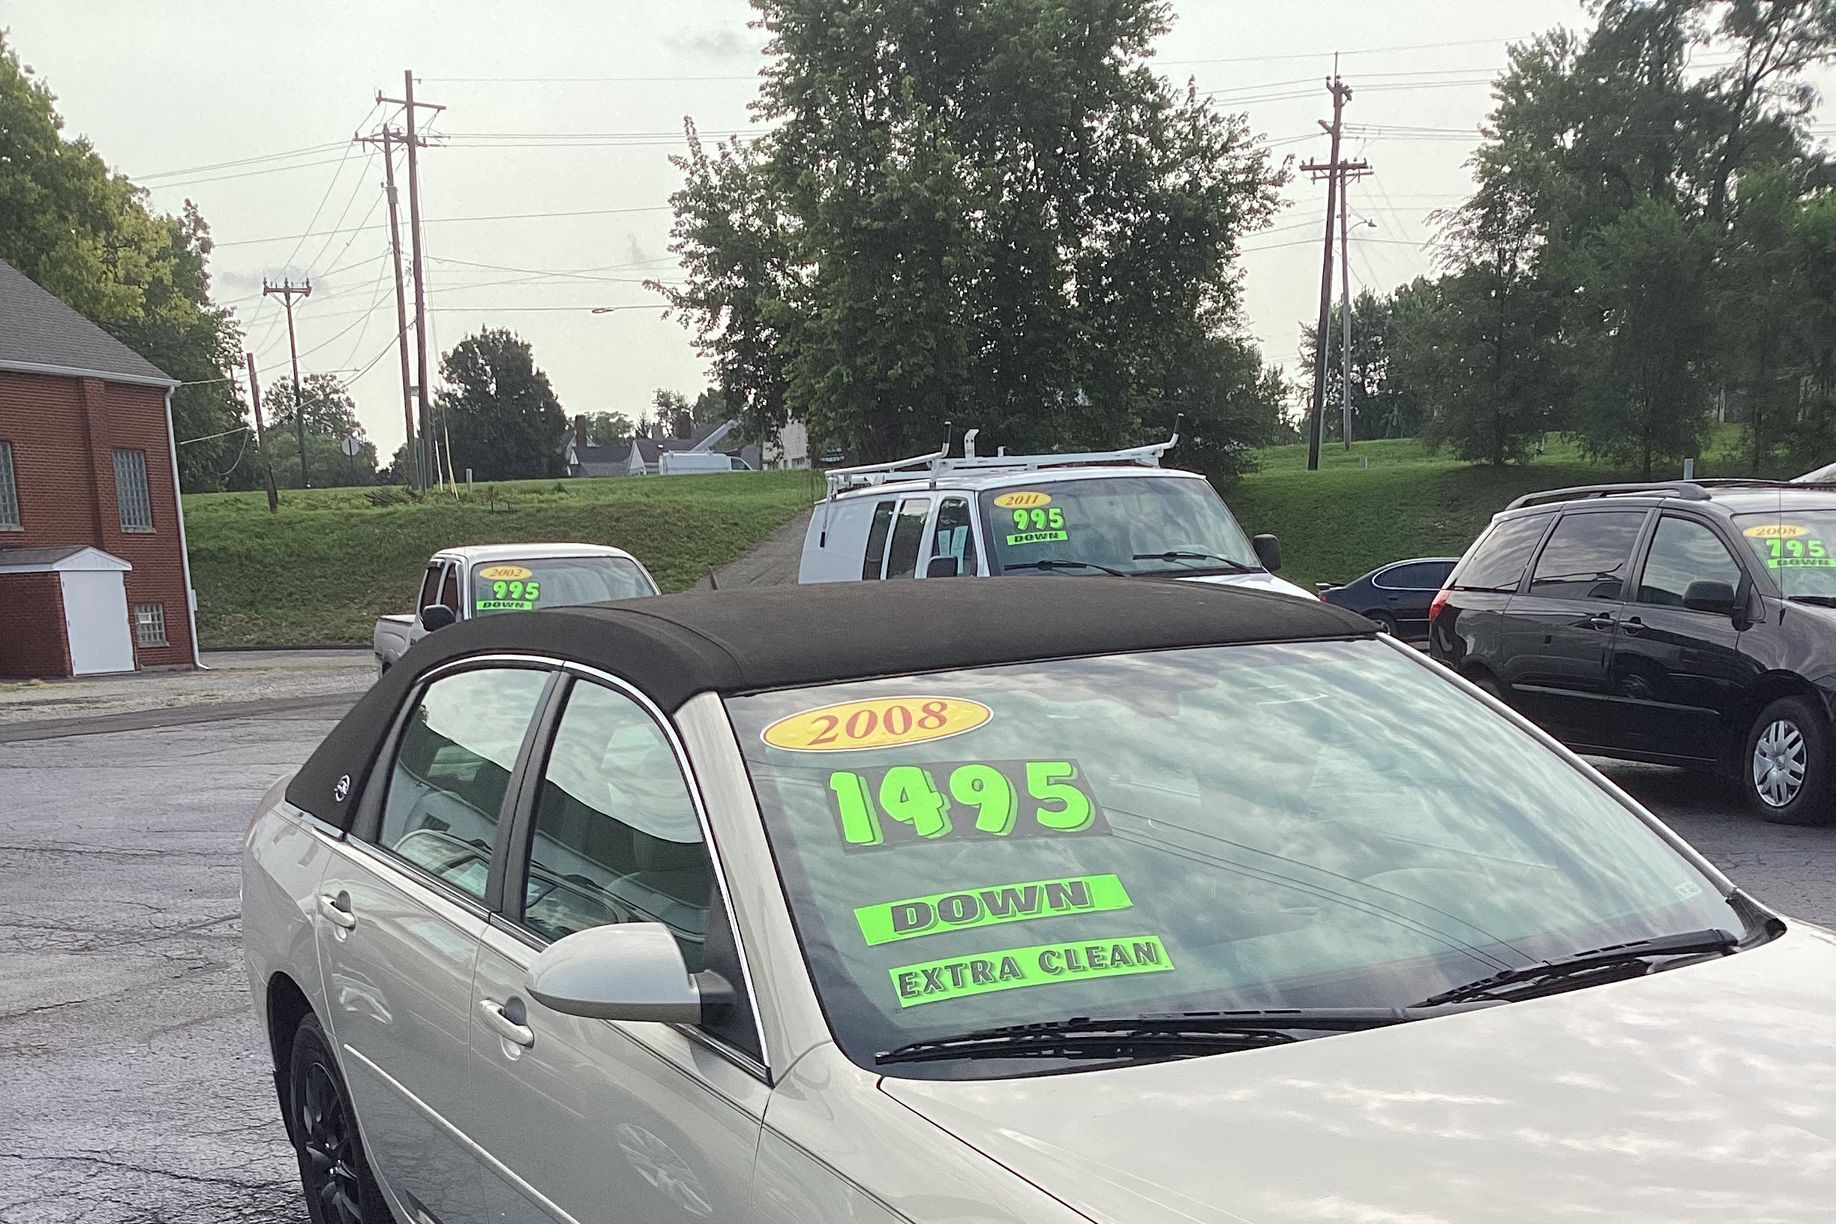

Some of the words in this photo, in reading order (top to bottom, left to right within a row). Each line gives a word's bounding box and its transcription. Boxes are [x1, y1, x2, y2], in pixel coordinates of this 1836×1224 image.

[1005, 494, 1040, 506] 2011
[1013, 508, 1065, 530] 995
[1013, 532, 1061, 543] DOWN
[1755, 526, 1798, 537] 2008
[1765, 539, 1826, 558] 795
[1776, 559, 1830, 567] DOWN
[489, 568, 523, 578] 2002
[492, 580, 540, 600] 995
[482, 601, 525, 609] DOWN
[806, 700, 949, 746] 2008
[829, 760, 1097, 846] 1495
[890, 881, 1096, 933] DOWN
[899, 955, 1024, 997] EXTRA
[1037, 941, 1160, 975] CLEAN
